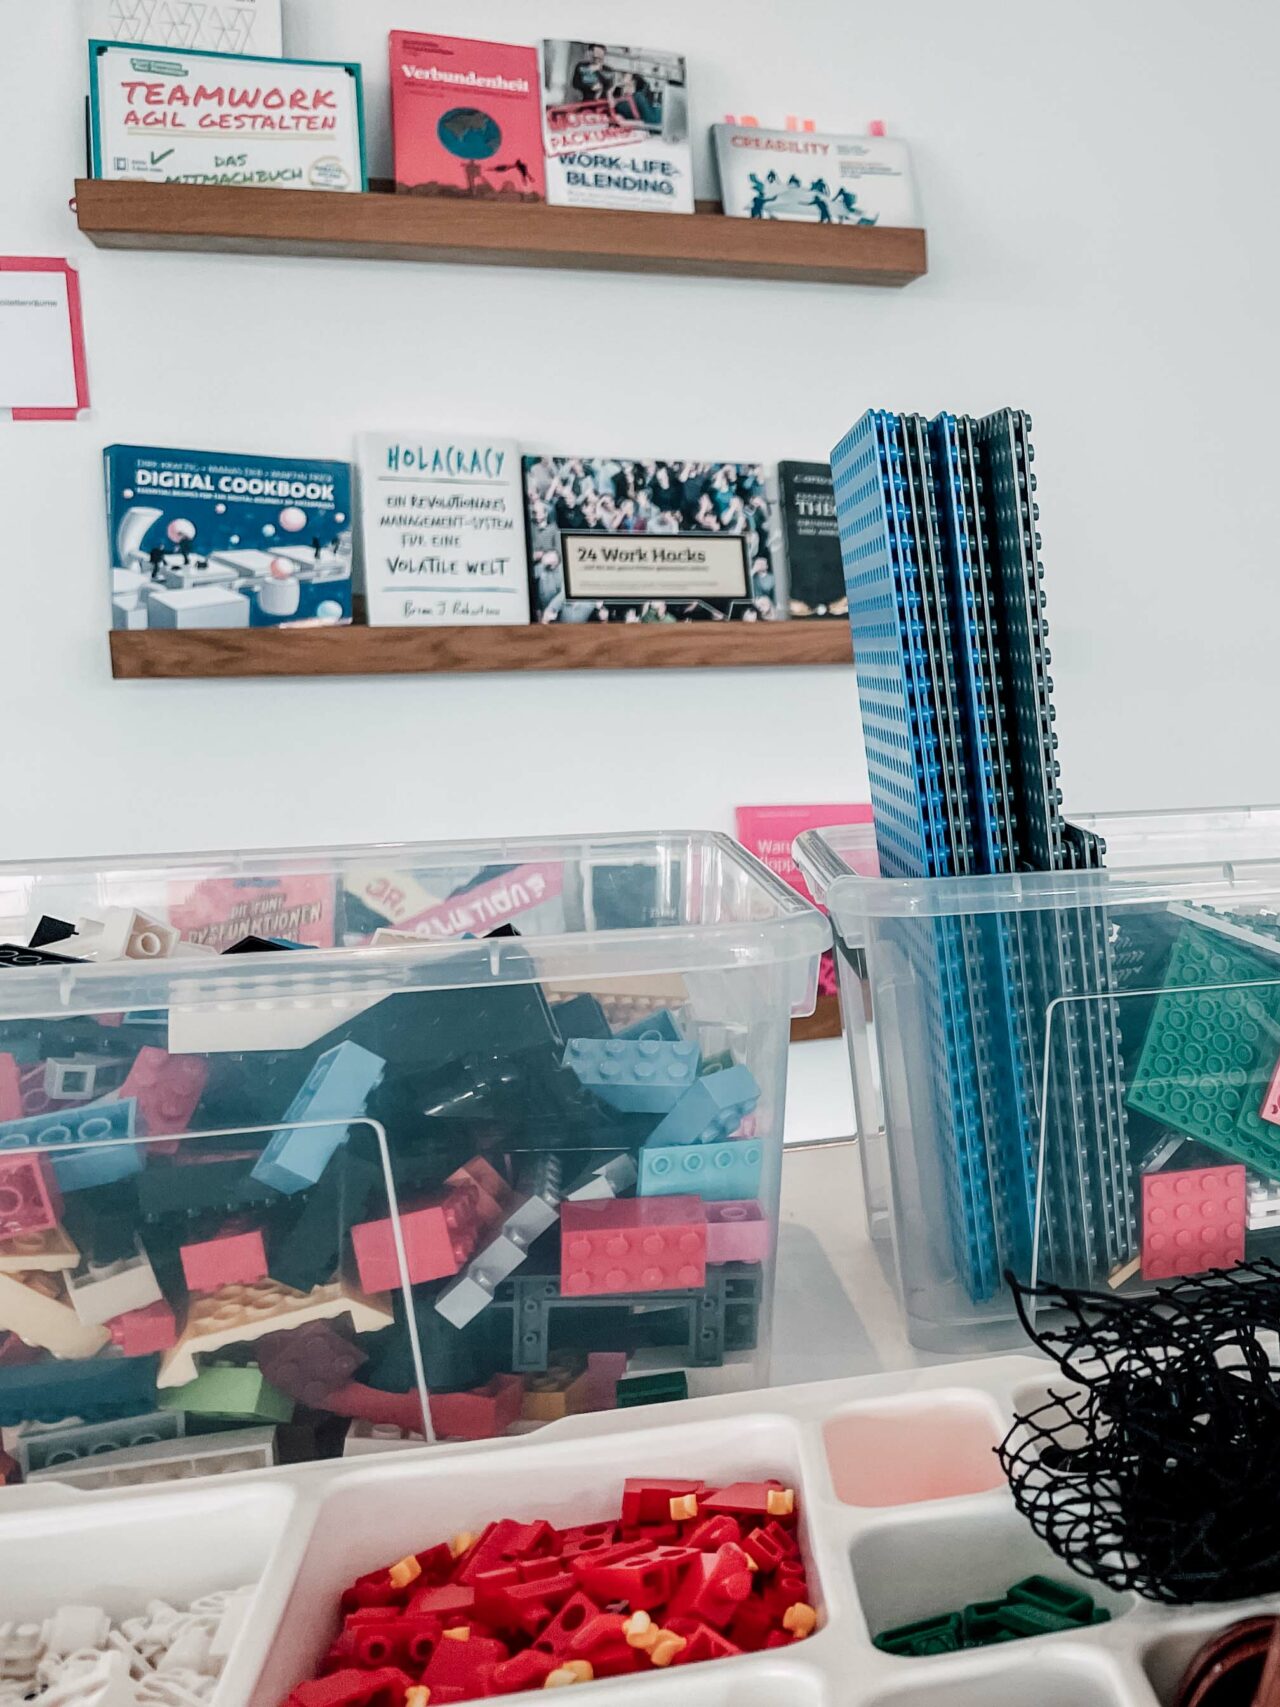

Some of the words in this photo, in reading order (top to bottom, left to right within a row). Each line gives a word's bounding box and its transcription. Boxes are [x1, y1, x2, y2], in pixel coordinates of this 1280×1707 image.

[401, 64, 530, 93] Verbundenheit
[121, 81, 337, 111] TEAMWORK
[124, 110, 186, 128] AGIL
[198, 112, 337, 130] GESTALTEN
[731, 135, 830, 156] CREABILITY
[214, 154, 248, 168] DAS
[566, 171, 676, 196] BLENDING
[387, 444, 505, 478] HOLACRACY
[136, 467, 215, 491] DIGITAL
[218, 475, 336, 501] COOKBOOK
[387, 555, 460, 575] VOLATILE
[466, 557, 511, 576] WELT
[577, 548, 598, 563] 24
[601, 547, 648, 563] Work
[652, 547, 707, 563] Hacks
